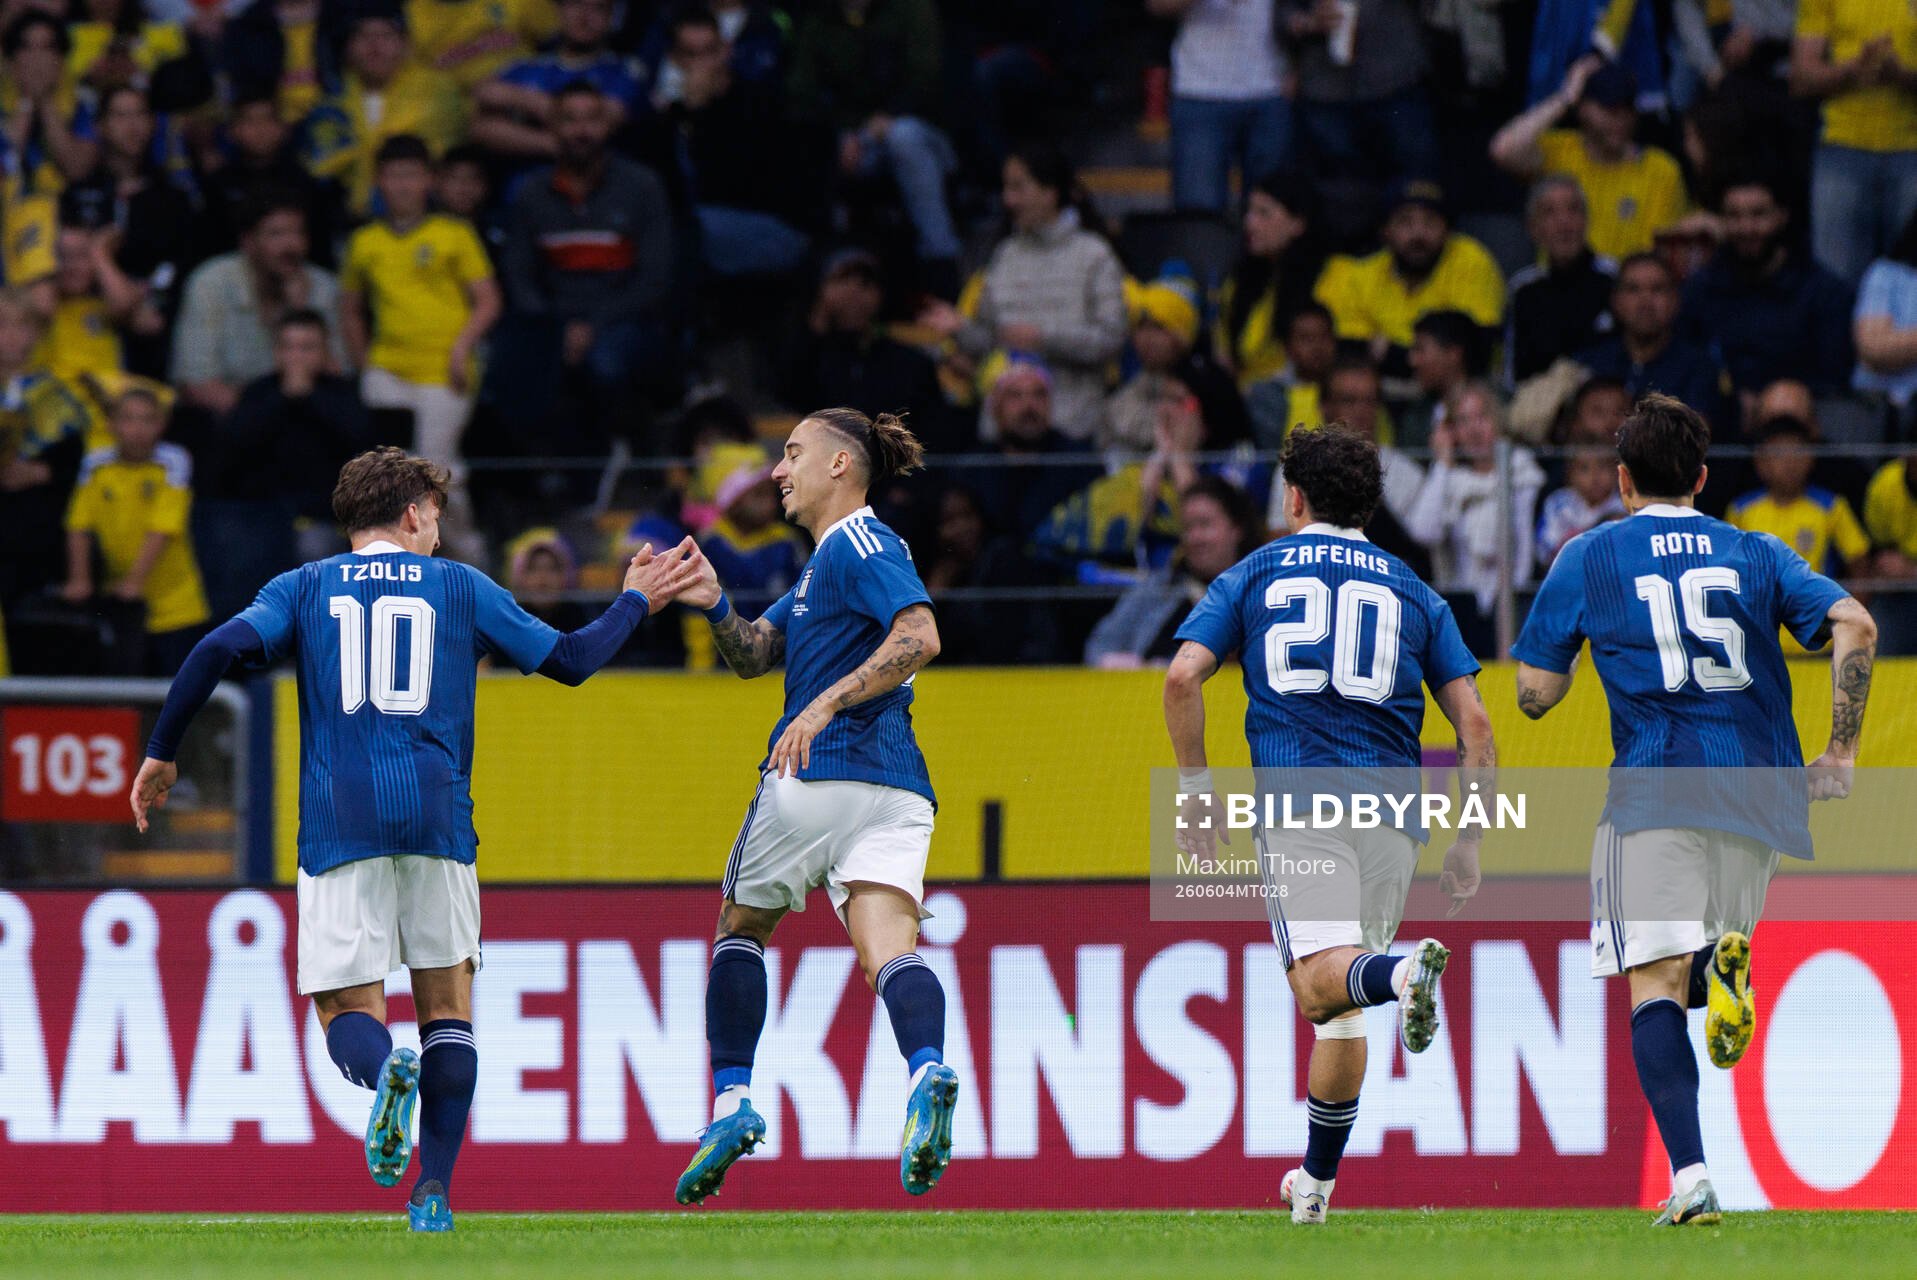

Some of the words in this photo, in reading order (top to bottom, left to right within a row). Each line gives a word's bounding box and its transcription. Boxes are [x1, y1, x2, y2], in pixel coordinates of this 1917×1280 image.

[339, 561, 423, 582] TZOLIS
[1280, 544, 1390, 576] ZAFEIRIS
[1650, 532, 1713, 557] ROTA
[329, 595, 437, 716] 10
[1264, 576, 1402, 705] 20
[1634, 566, 1754, 693] 15
[12, 735, 127, 796] 103
